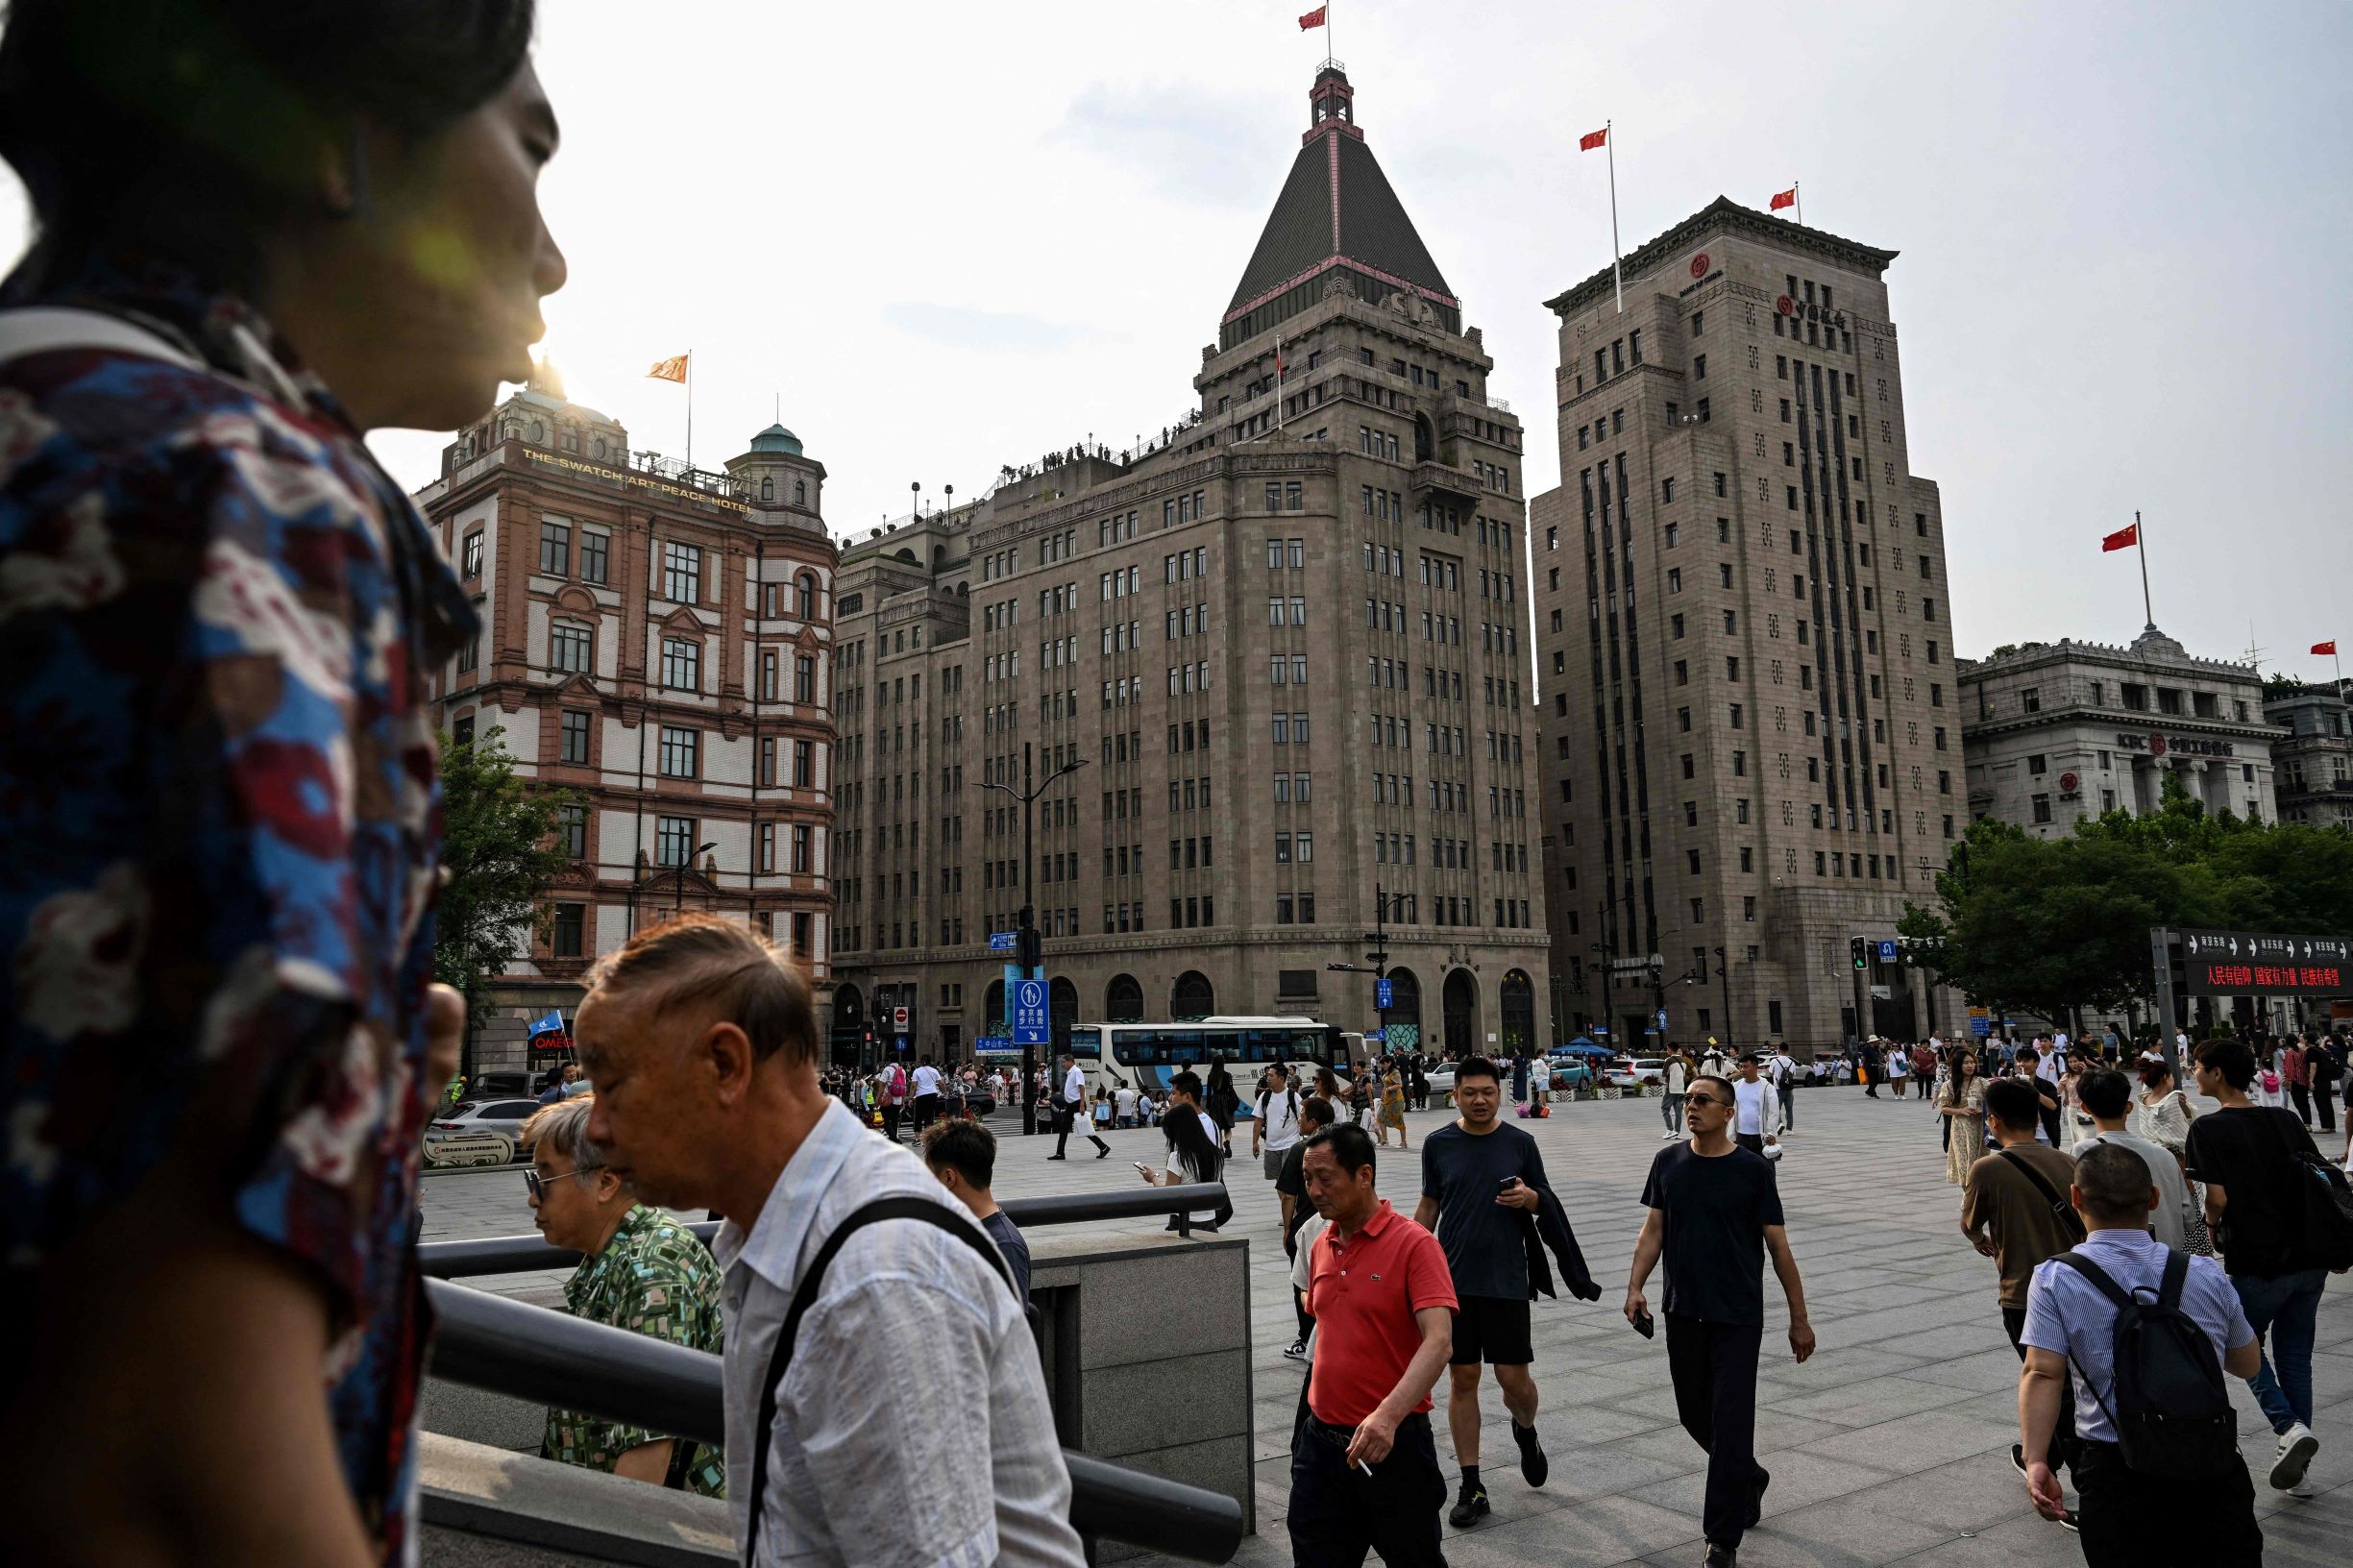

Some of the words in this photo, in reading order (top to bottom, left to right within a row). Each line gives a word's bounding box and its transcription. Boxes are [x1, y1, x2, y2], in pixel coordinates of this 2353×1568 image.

[522, 449, 554, 464] THE
[559, 458, 622, 481] SWATCH
[627, 476, 657, 488] ART
[661, 483, 707, 502] PEACE
[711, 497, 753, 514] HOTEL
[2117, 733, 2147, 749] ICBC
[2208, 965, 2252, 986] 人民有信仰
[2254, 967, 2298, 987] 国家有力量
[2300, 968, 2341, 987] 民族有希望
[1018, 1008, 1044, 1017] 南京路
[1018, 1017, 1044, 1025] 步行街
[535, 1037, 575, 1048] OMEG
